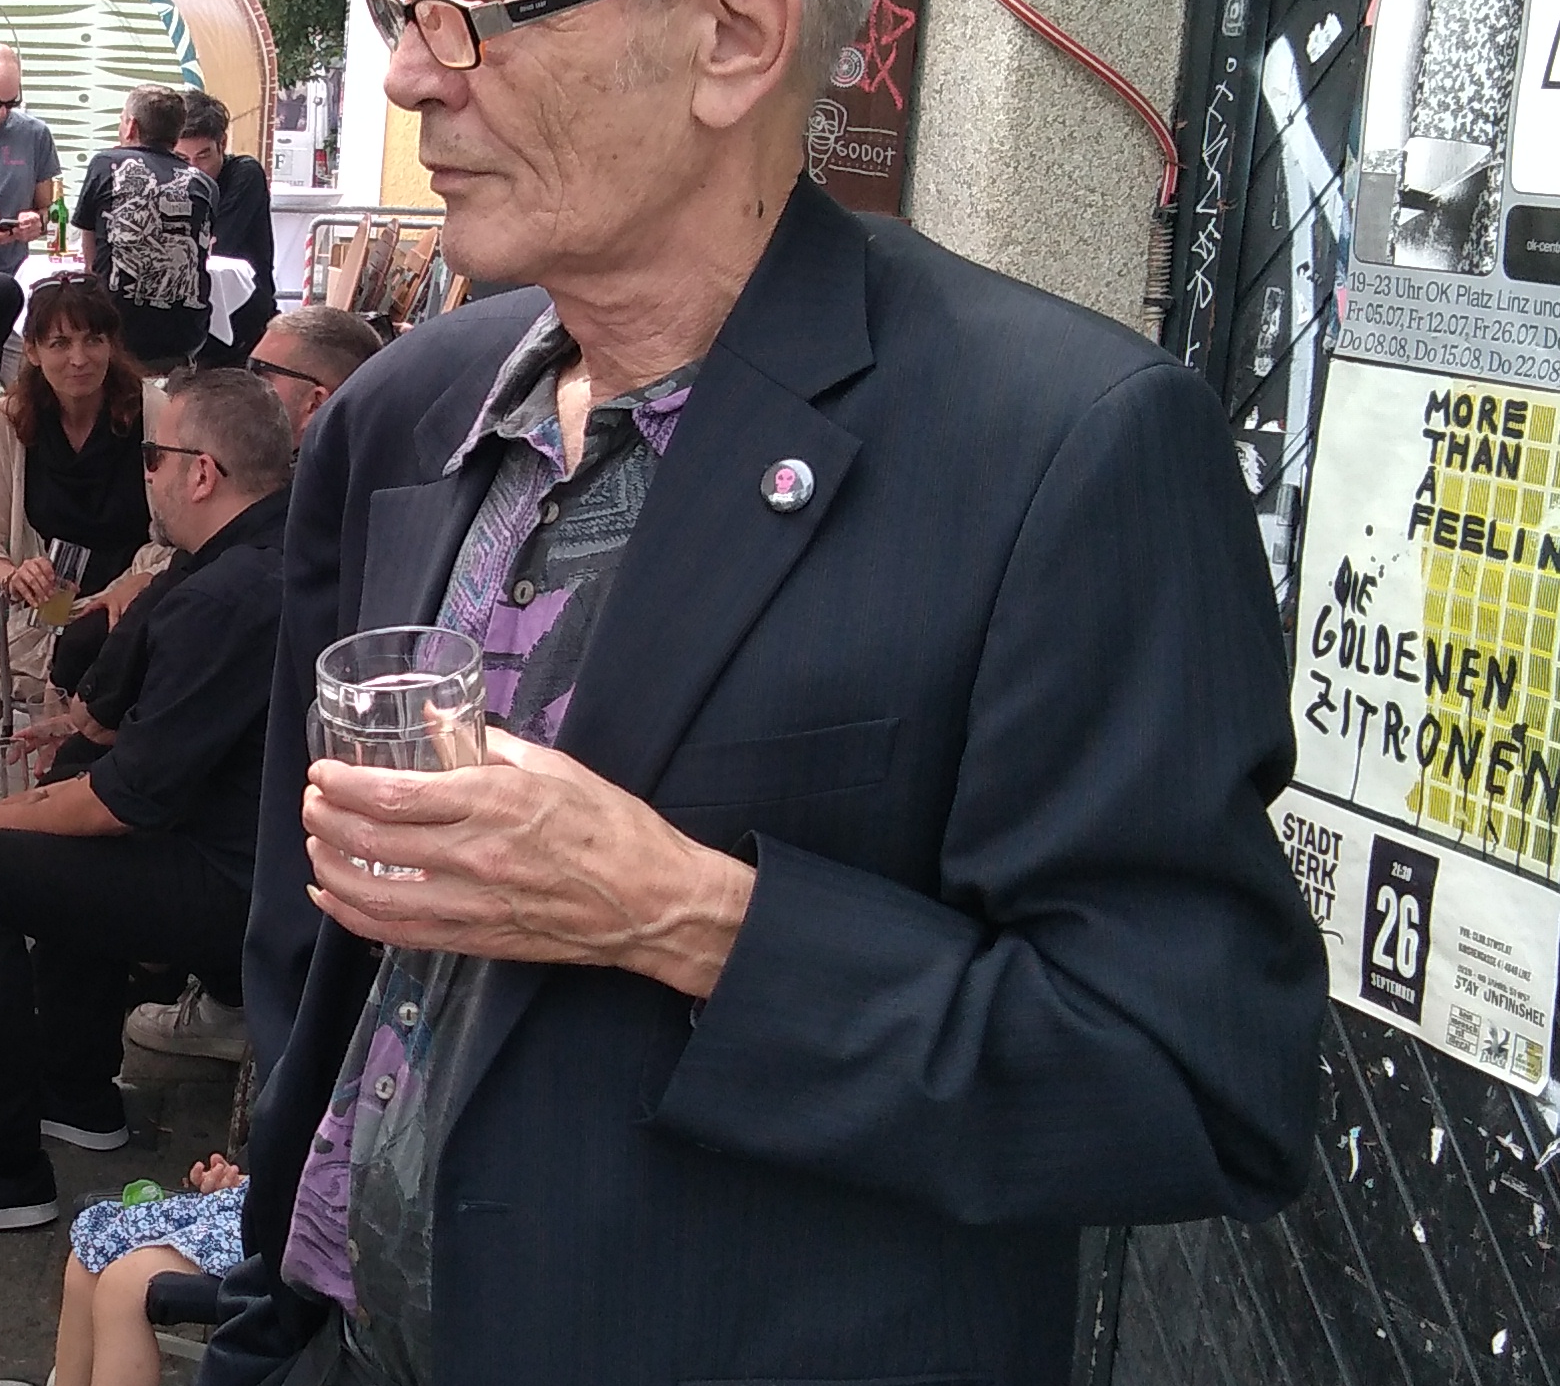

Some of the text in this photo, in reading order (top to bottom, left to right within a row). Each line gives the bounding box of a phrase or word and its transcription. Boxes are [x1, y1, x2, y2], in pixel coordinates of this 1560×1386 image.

[1345, 300, 1363, 322] Fr
[1406, 308, 1425, 331] Fr
[1472, 317, 1490, 340] Fr
[1395, 276, 1423, 301] Uhr
[1425, 281, 1451, 304] OK
[1455, 284, 1493, 310] Platz
[1496, 289, 1530, 315] Linz
[1339, 328, 1362, 351] Do
[1364, 332, 1410, 363] 08.08,
[1413, 339, 1437, 362] Do
[1439, 344, 1484, 374] 15.08,
[1487, 350, 1512, 374] Do
[1424, 388, 1529, 440] MORE
[1422, 428, 1522, 481] THAN
[1415, 466, 1437, 505] A
[1333, 556, 1378, 616] DIE
[1312, 604, 1518, 712] GOLDENEN
[1304, 669, 1560, 810] ZITRONEN
[1282, 811, 1344, 862] STADT
[1372, 884, 1420, 980] 26
[1370, 972, 1416, 1005] SEPTEMBER
[1454, 974, 1480, 997] STAY
